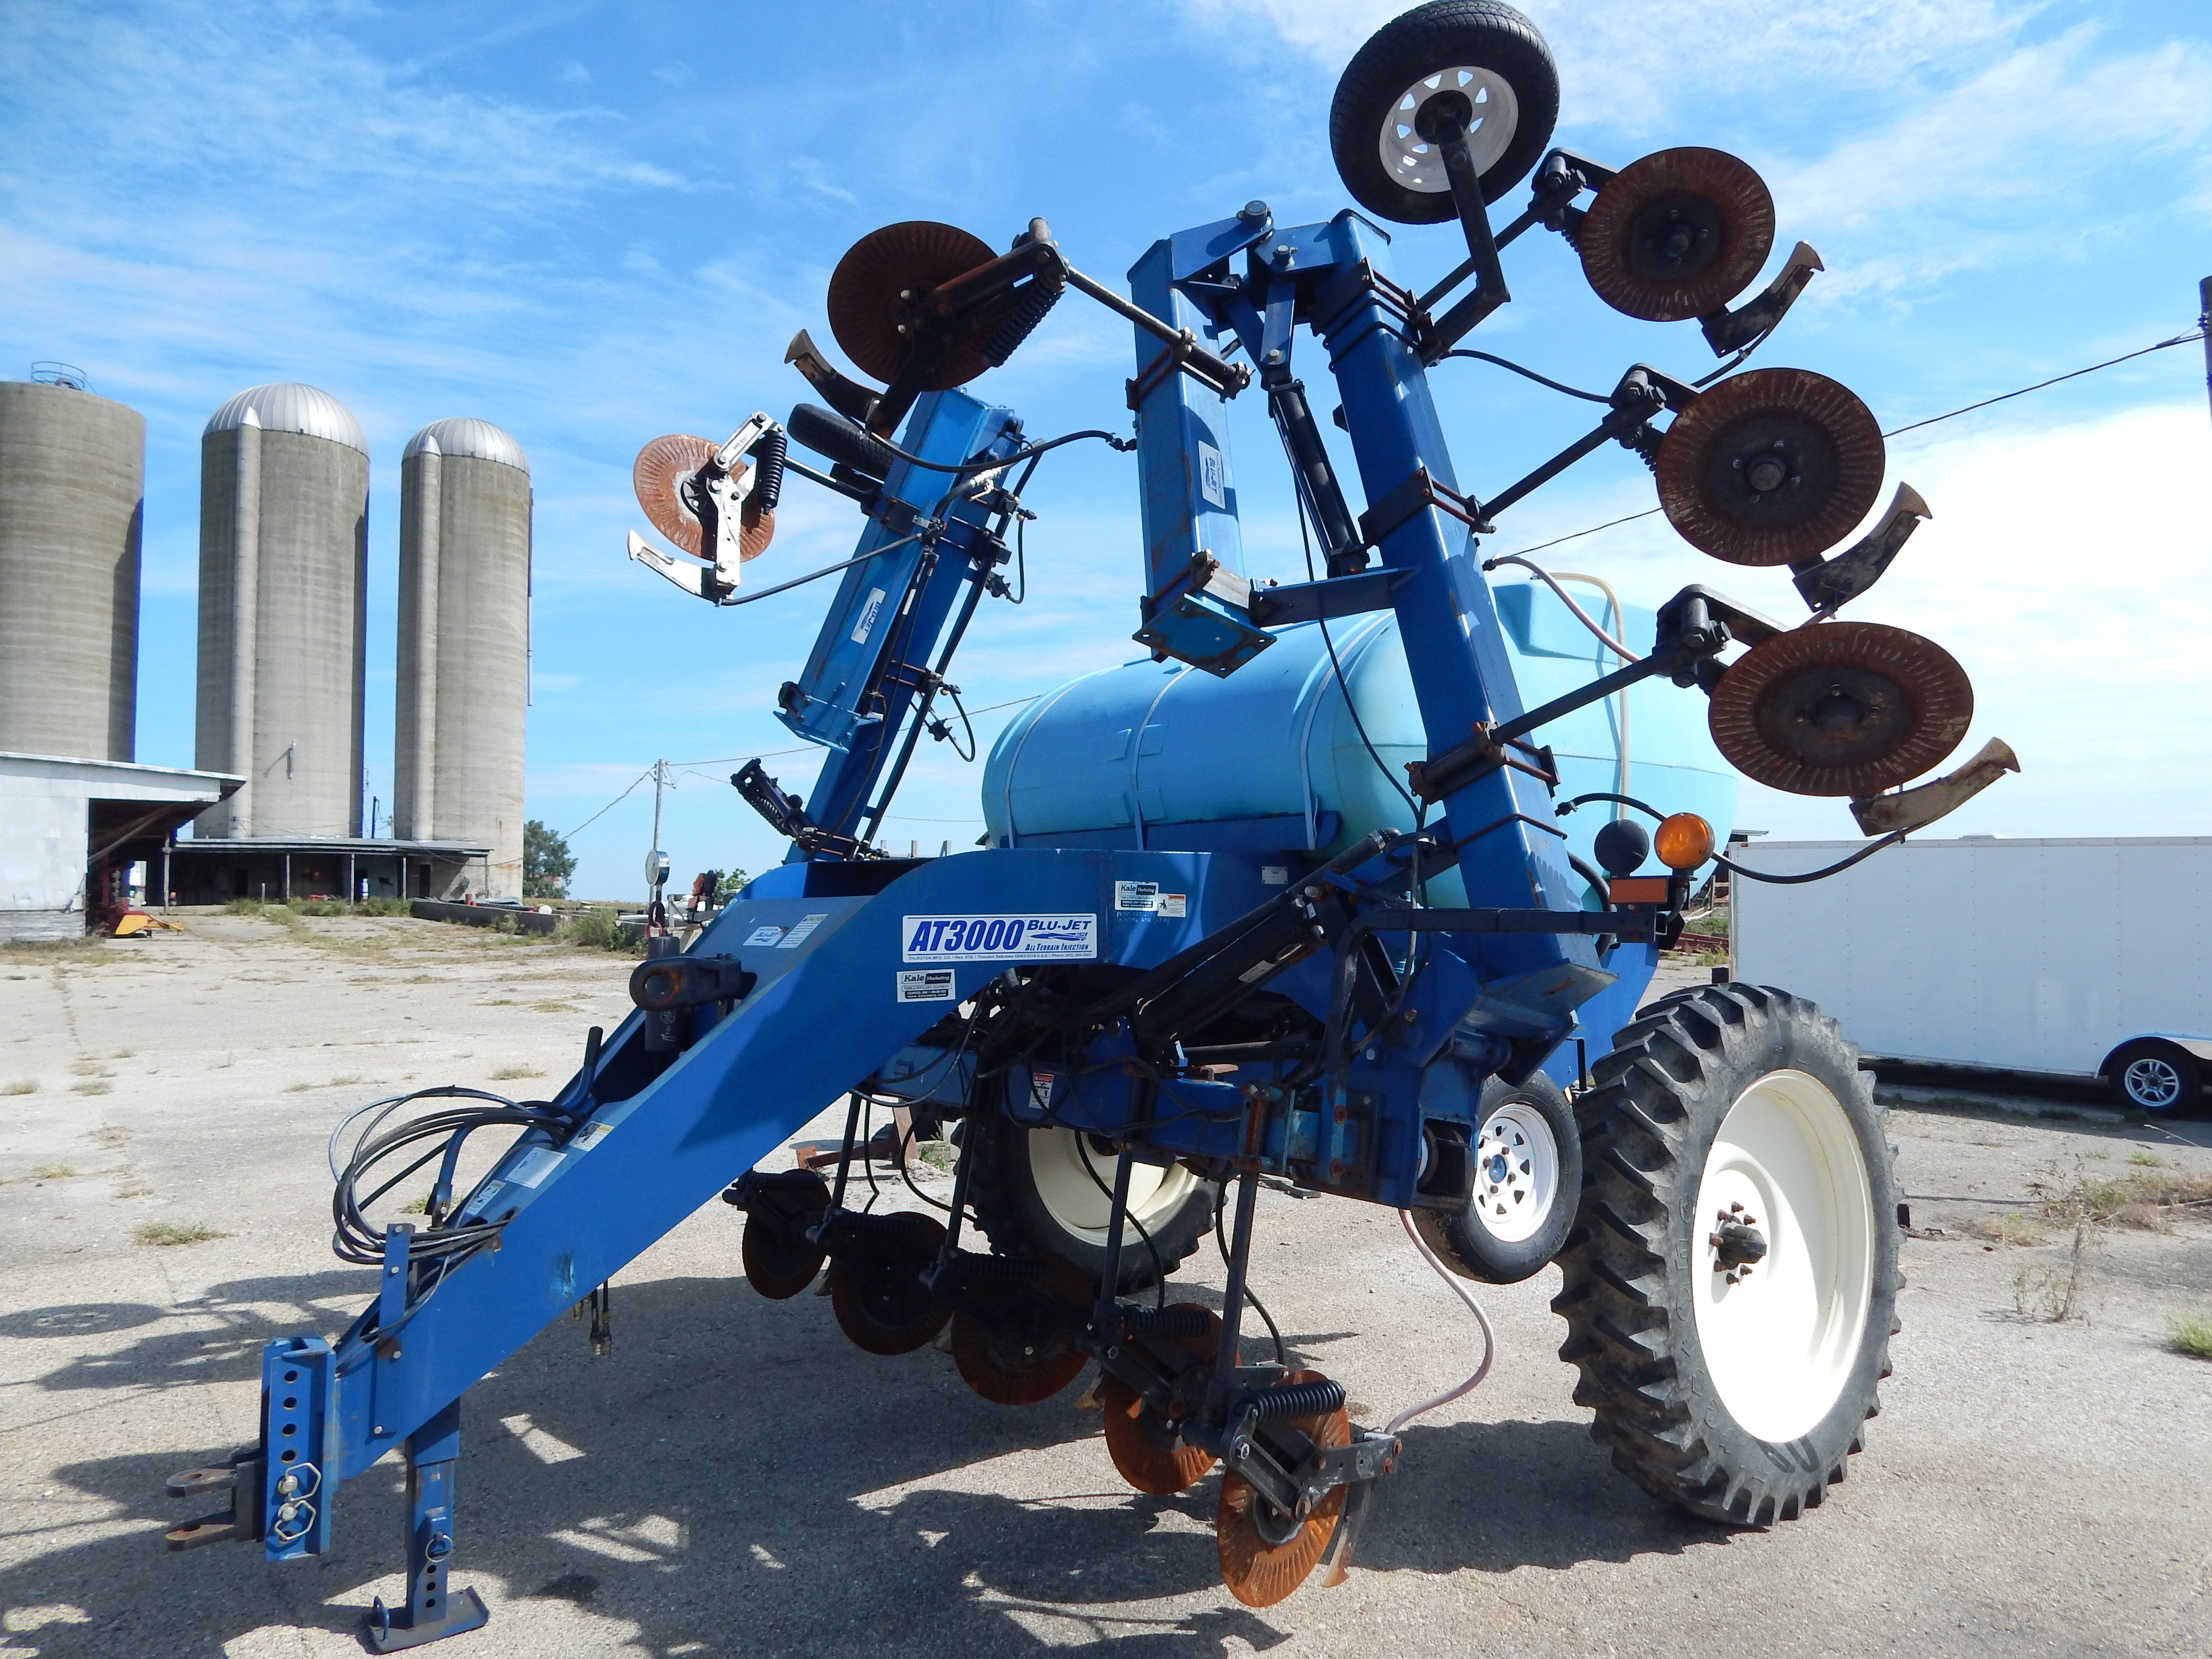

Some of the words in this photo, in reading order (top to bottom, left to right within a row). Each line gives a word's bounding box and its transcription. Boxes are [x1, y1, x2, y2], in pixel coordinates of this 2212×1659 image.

[864, 601, 881, 634] BLU-JET
[1026, 919, 1092, 930] BLU-JET
[908, 920, 1025, 951] AT3000
[904, 974, 925, 982] Kale
